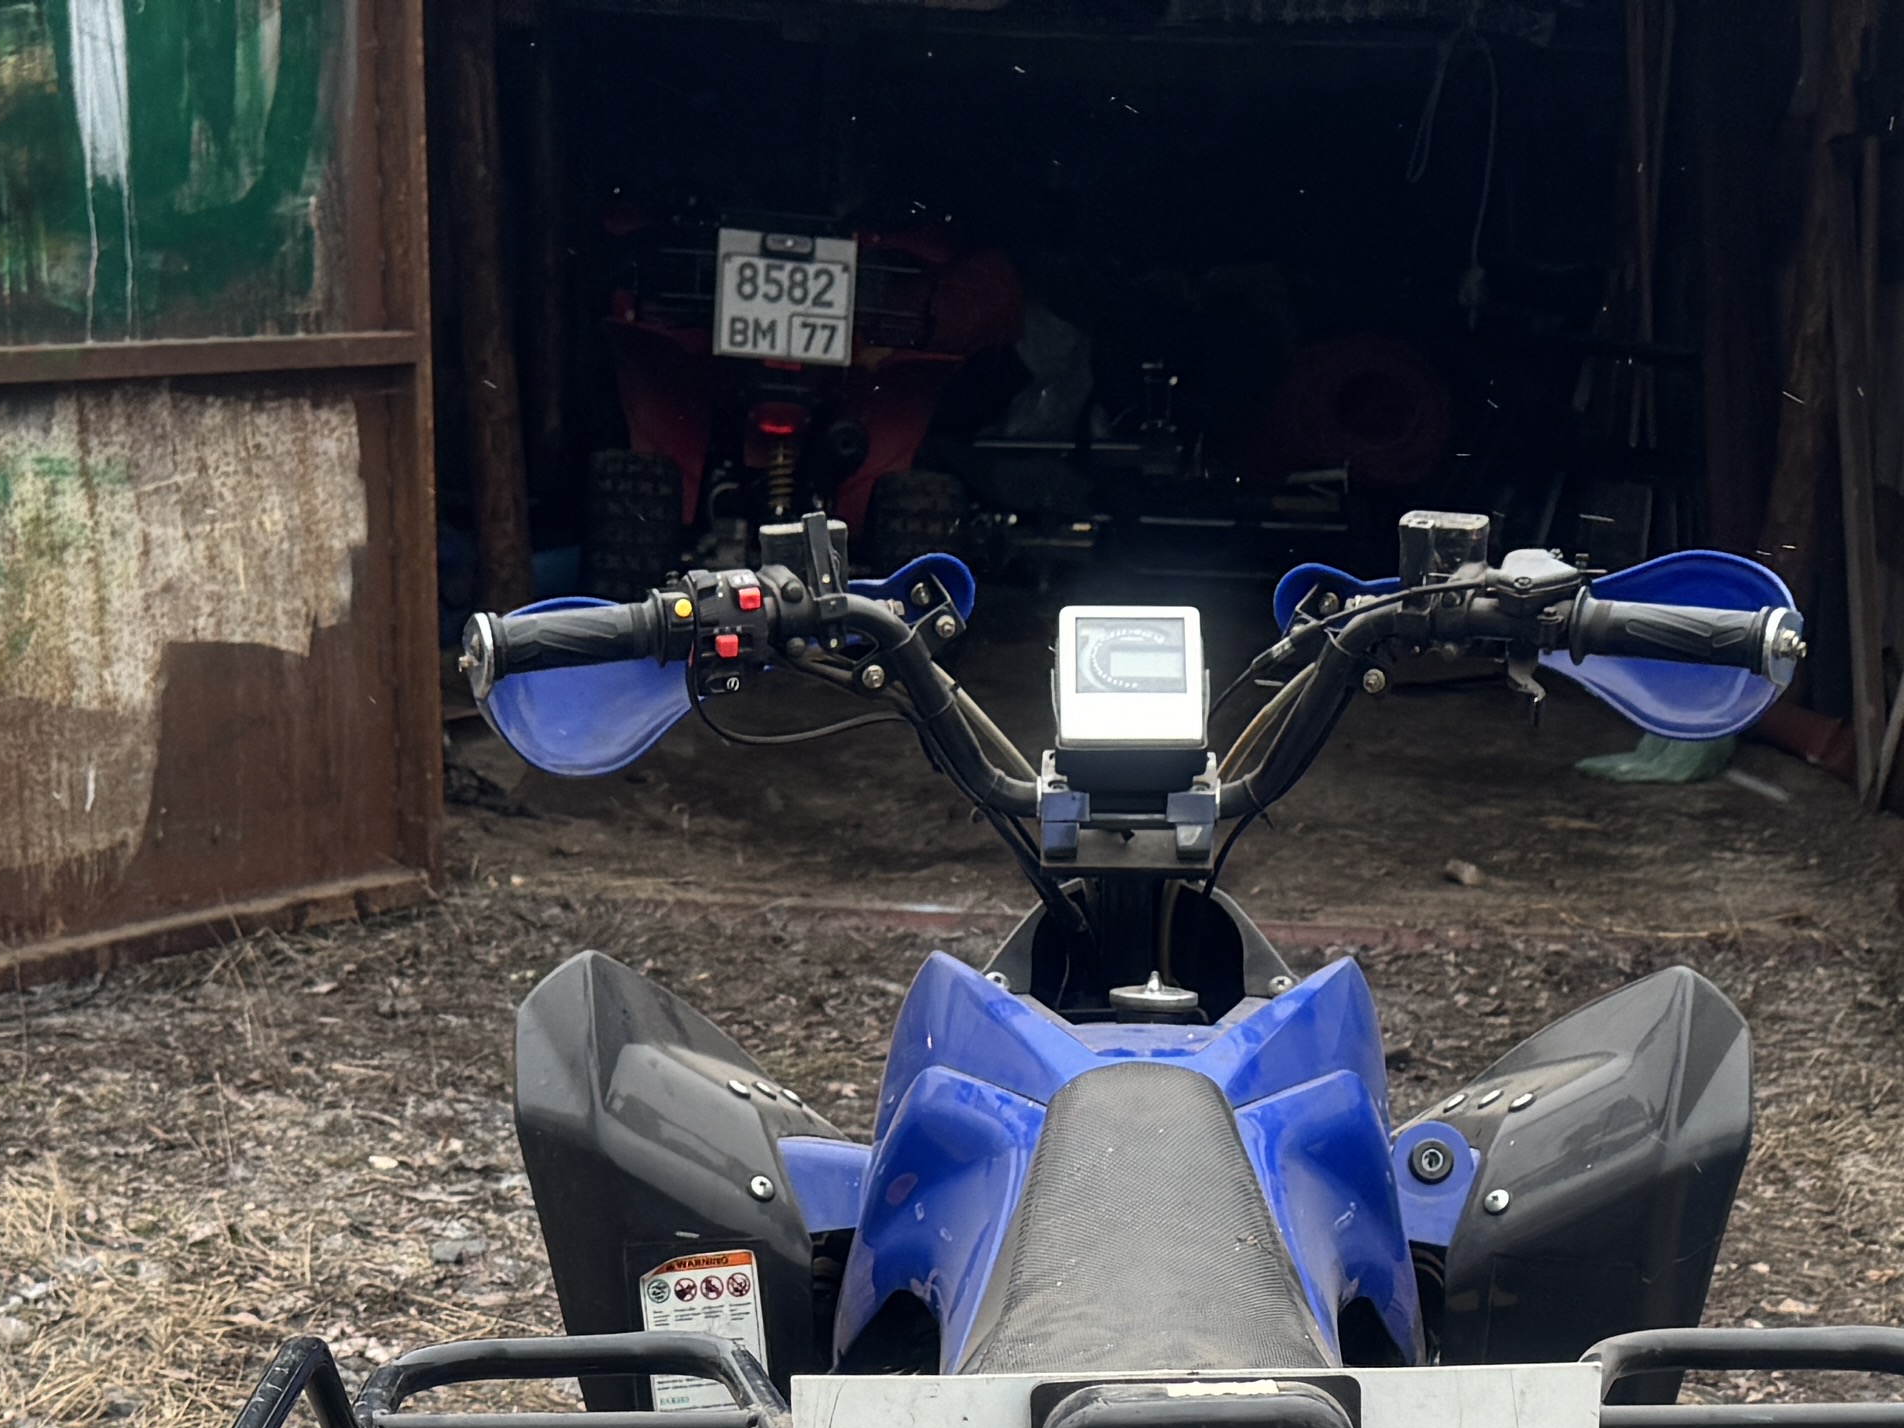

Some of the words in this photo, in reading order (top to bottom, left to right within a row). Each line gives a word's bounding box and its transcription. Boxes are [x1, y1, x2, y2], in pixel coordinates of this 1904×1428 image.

[736, 261, 835, 308] 8582
[800, 320, 838, 354] 77
[676, 1255, 729, 1269] WARNING
